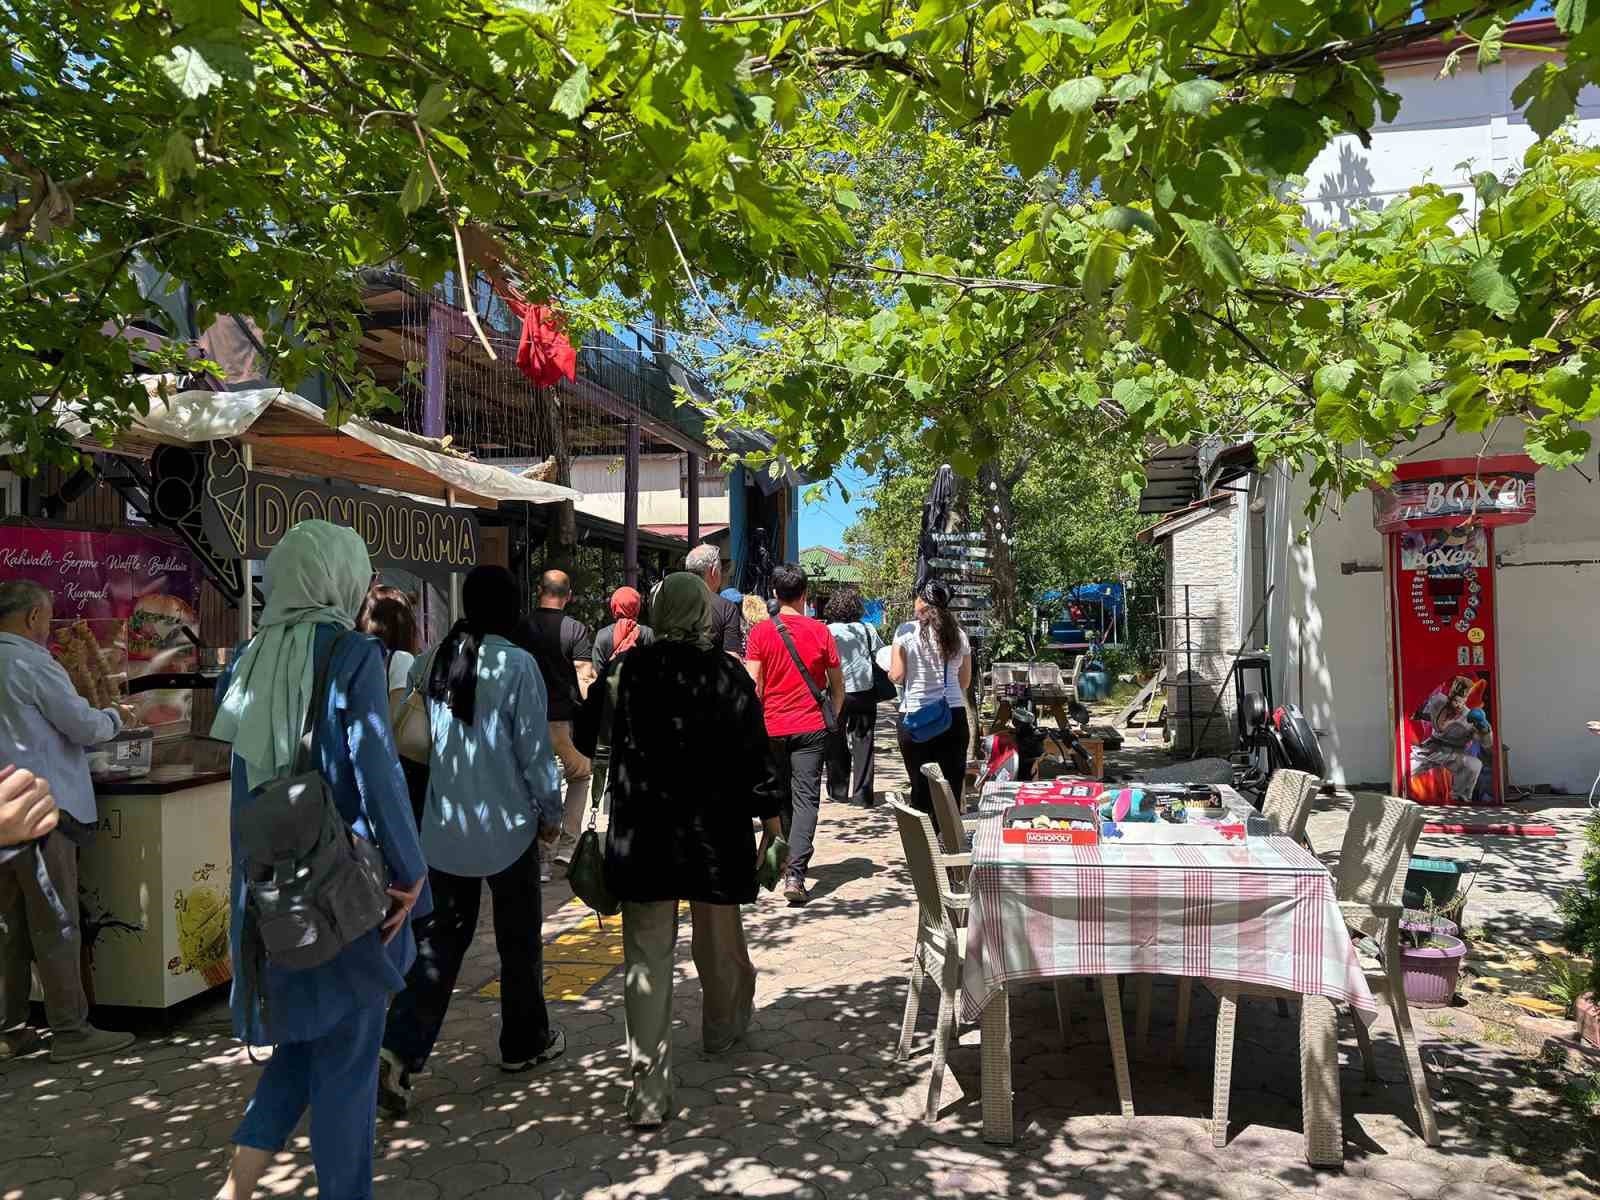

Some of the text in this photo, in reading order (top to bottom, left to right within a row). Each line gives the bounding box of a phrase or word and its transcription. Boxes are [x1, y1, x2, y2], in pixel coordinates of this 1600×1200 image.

[1425, 477, 1526, 513] BOXER
[256, 484, 475, 566] DONDURMA
[106, 554, 140, 573] Waffle
[1027, 833, 1071, 843] MONOPOLY
